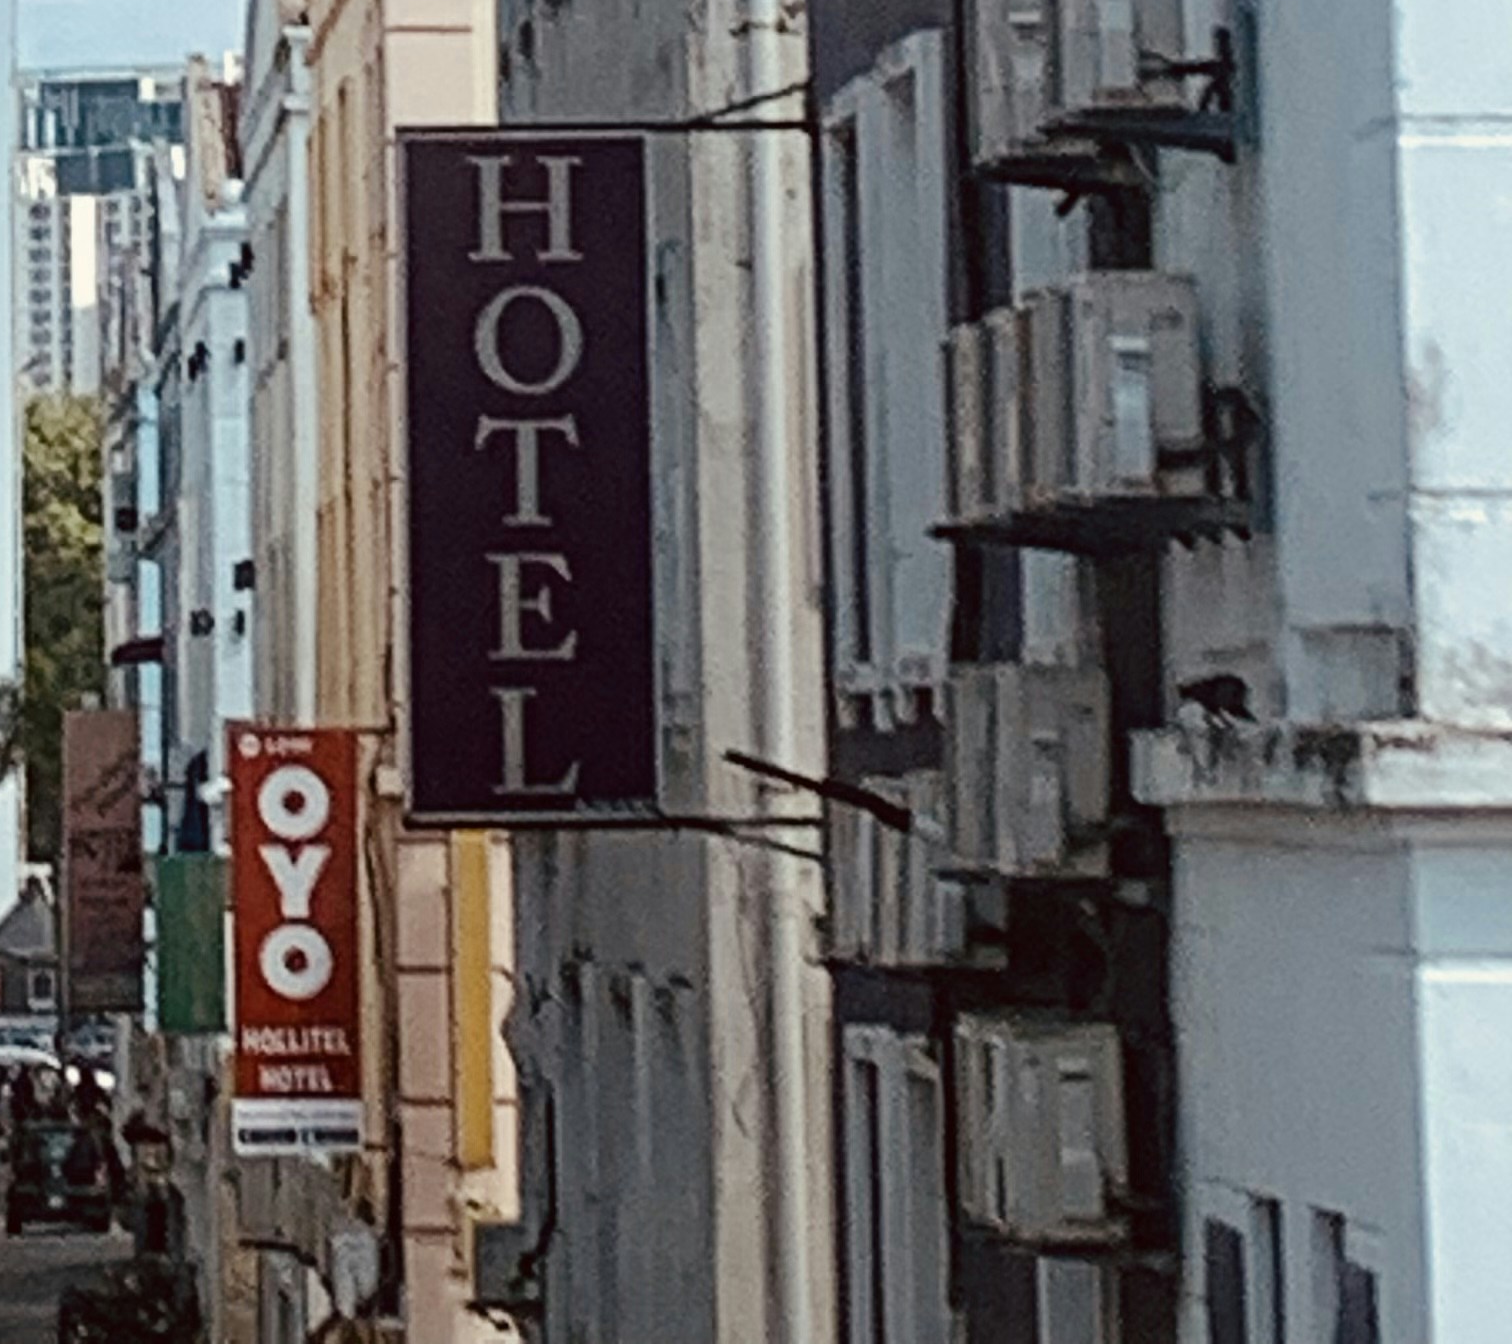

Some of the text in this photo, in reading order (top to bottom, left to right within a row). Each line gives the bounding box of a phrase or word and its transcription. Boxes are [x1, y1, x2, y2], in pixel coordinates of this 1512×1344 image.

[465, 153, 584, 796] HOTEL
[257, 764, 333, 1001] OYO
[258, 1063, 333, 1092] HOTEL
